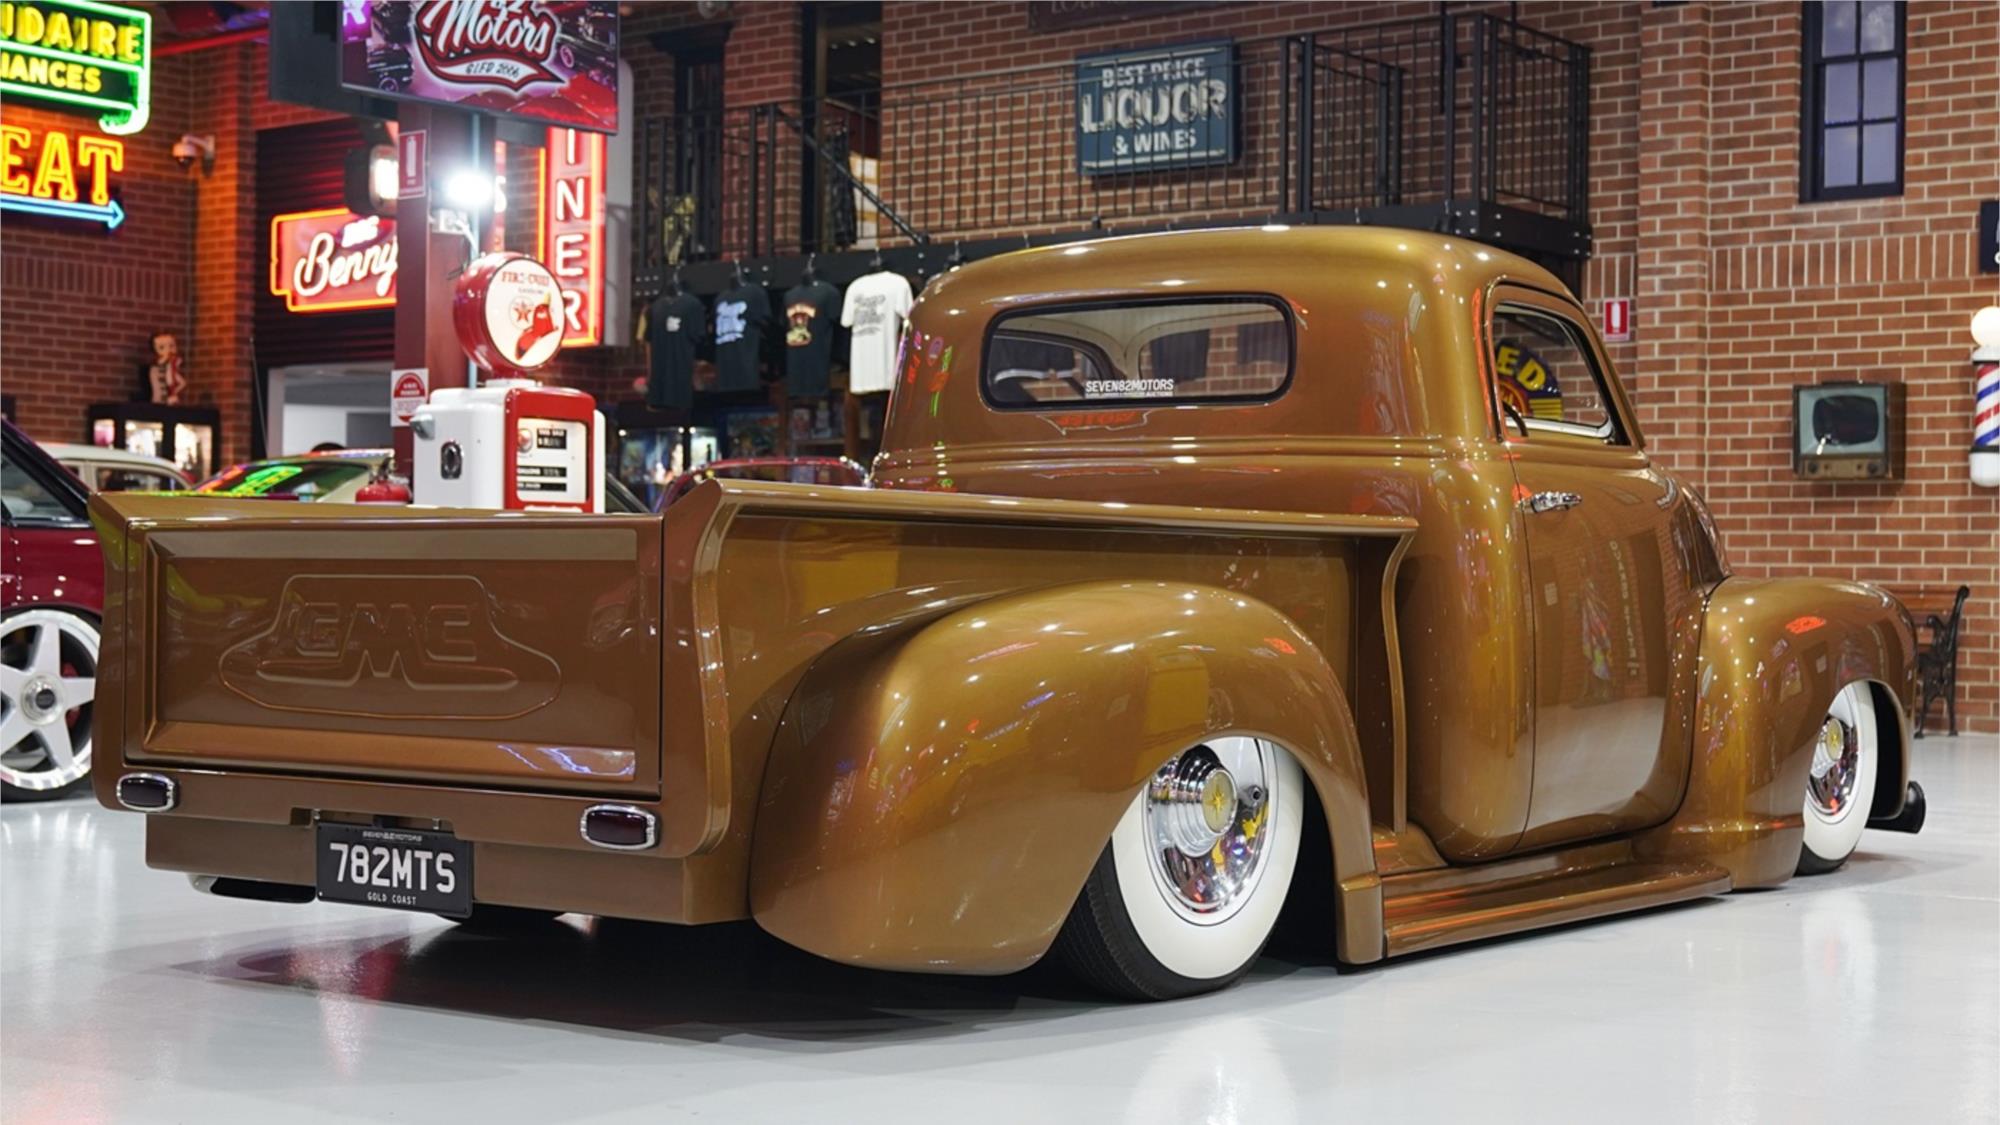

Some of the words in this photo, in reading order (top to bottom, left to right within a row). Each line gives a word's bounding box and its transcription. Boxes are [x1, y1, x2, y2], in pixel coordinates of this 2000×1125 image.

[422, 1, 551, 54] Motors
[1102, 63, 1146, 88] BEST
[1150, 57, 1206, 82] PRICE
[1080, 79, 1227, 133] LIQUOR
[1, 124, 124, 207] EAT
[1113, 135, 1129, 155] &
[1134, 129, 1197, 154] WINES
[1085, 379, 1174, 393] SEVEN82MOTORS
[256, 603, 519, 692] GMC
[330, 843, 455, 893] 782MTS
[367, 891, 388, 902] GOLD
[392, 895, 417, 905] COAST
